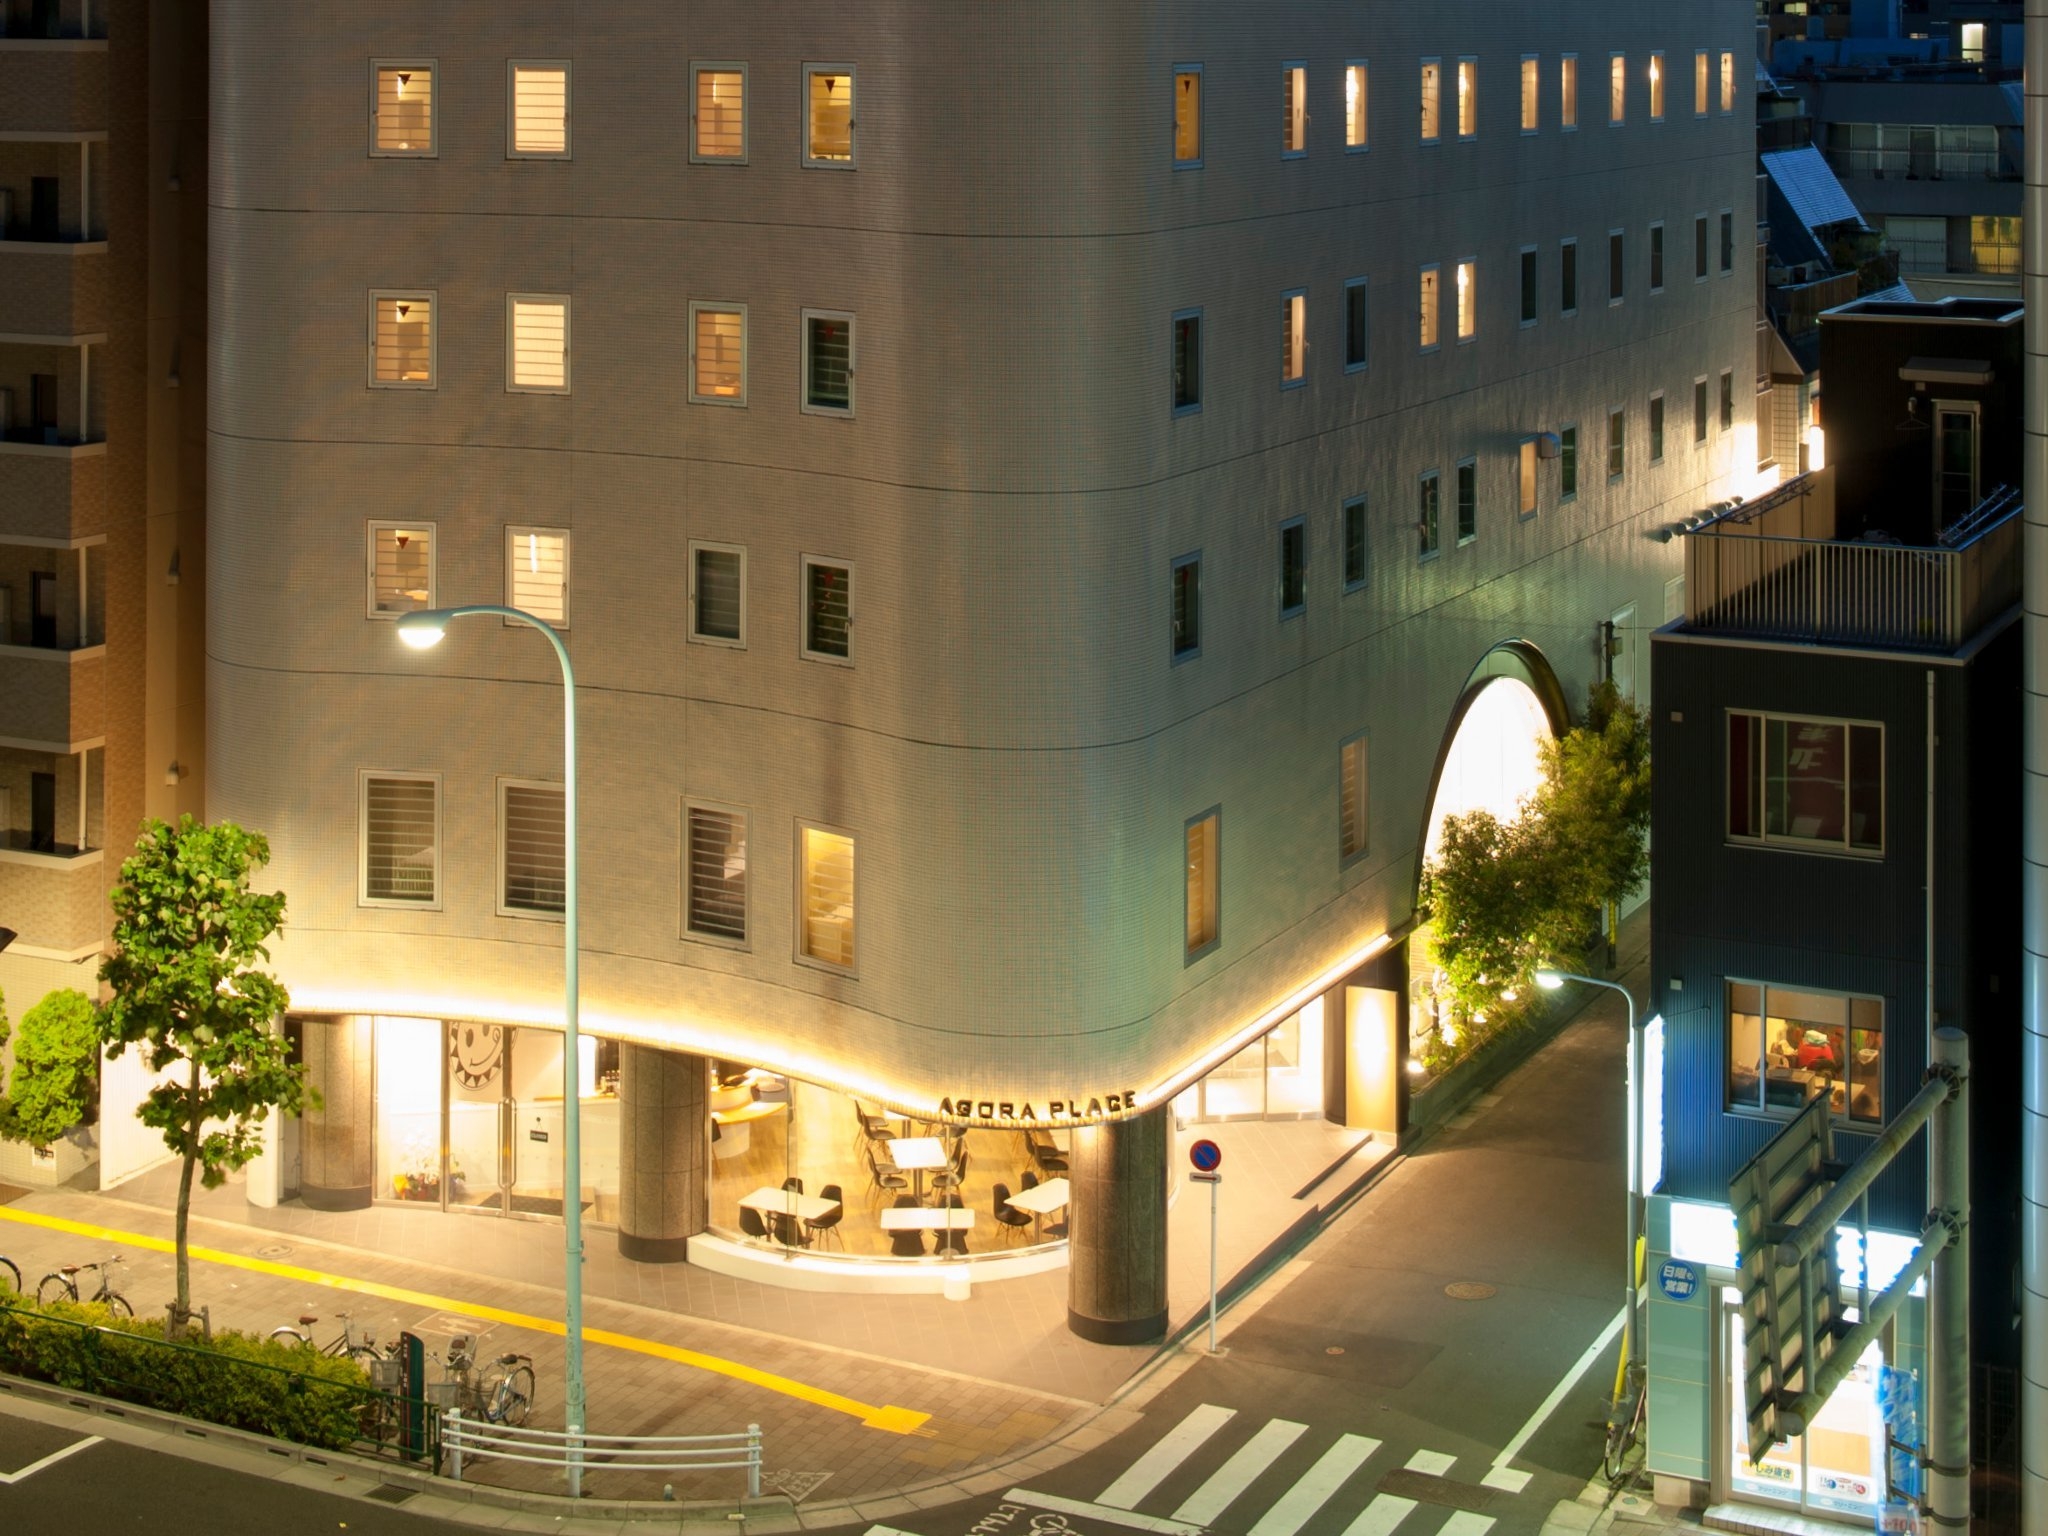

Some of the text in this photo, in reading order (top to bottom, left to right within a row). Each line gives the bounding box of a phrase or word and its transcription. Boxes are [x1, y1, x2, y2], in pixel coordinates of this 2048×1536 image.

[939, 1090, 1136, 1120] AGORA PLACE
[1663, 1265, 1694, 1280] 日曜も
